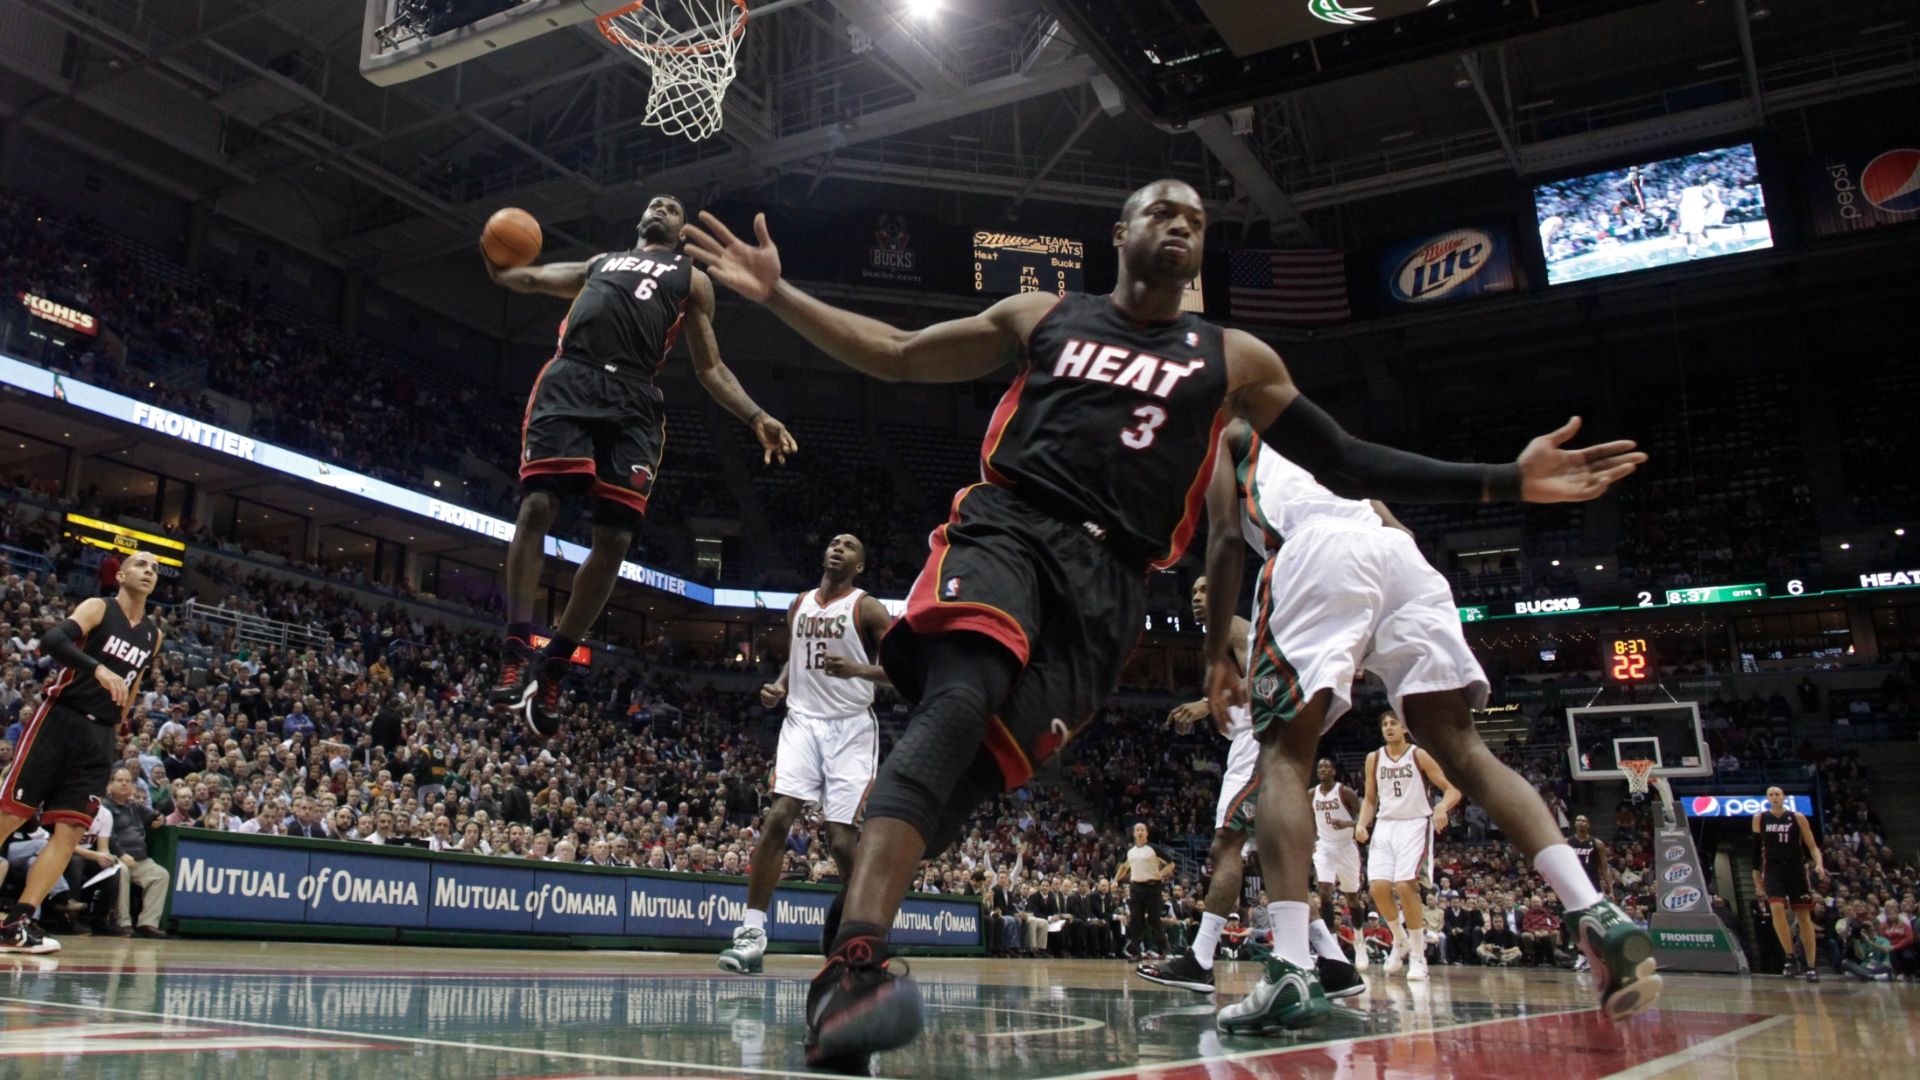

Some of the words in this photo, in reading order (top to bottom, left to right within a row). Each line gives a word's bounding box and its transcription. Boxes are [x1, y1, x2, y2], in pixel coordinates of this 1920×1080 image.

[1826, 164, 1862, 219] pepsi
[1040, 236, 1070, 247] TEAM
[1423, 237, 1468, 263] Miller
[873, 248, 912, 269] BUCKS
[974, 250, 998, 260] Heat
[1051, 258, 1081, 269] Bucks
[601, 256, 678, 278] HEAT
[862, 269, 921, 282] bucks.com
[1022, 266, 1035, 276] FT
[1411, 243, 1482, 298] Lite
[634, 278, 658, 300] 6
[1020, 276, 1039, 286] FTA
[1053, 339, 1204, 398] HEAT
[133, 401, 255, 461] FRONTIER
[1120, 404, 1166, 449] 3
[429, 500, 515, 542] FRONTIER
[618, 561, 686, 596] FRONTIER
[1515, 597, 1580, 614] BUCKS
[1638, 591, 1653, 607] 2
[1669, 589, 1711, 604] 8:37
[1787, 579, 1804, 595] 6
[1859, 570, 1920, 587] HEAT
[797, 613, 847, 639] BUCKS
[102, 634, 151, 668] HEAT
[805, 641, 827, 670] 12
[1614, 639, 1647, 655] 8:37
[1613, 654, 1646, 679] 22
[124, 670, 138, 689] 8
[1380, 763, 1413, 779] BUCKS
[1393, 781, 1402, 797] 6
[1315, 798, 1340, 811] BUCKS
[1765, 823, 1792, 832] HEAT
[1778, 833, 1789, 843] 11
[176, 857, 290, 898] MUTUAL
[298, 867, 331, 909] of
[332, 870, 419, 906] OMAHA
[434, 877, 520, 911] MUTUAL
[525, 883, 551, 920] of
[551, 886, 617, 916] OMAHA
[631, 890, 695, 919] MUTUAL
[698, 894, 717, 926] of
[1671, 892, 1698, 909] Lite
[934, 910, 944, 936] of
[945, 912, 976, 932] OMAHA
[1660, 933, 1714, 942] FRONTIER
